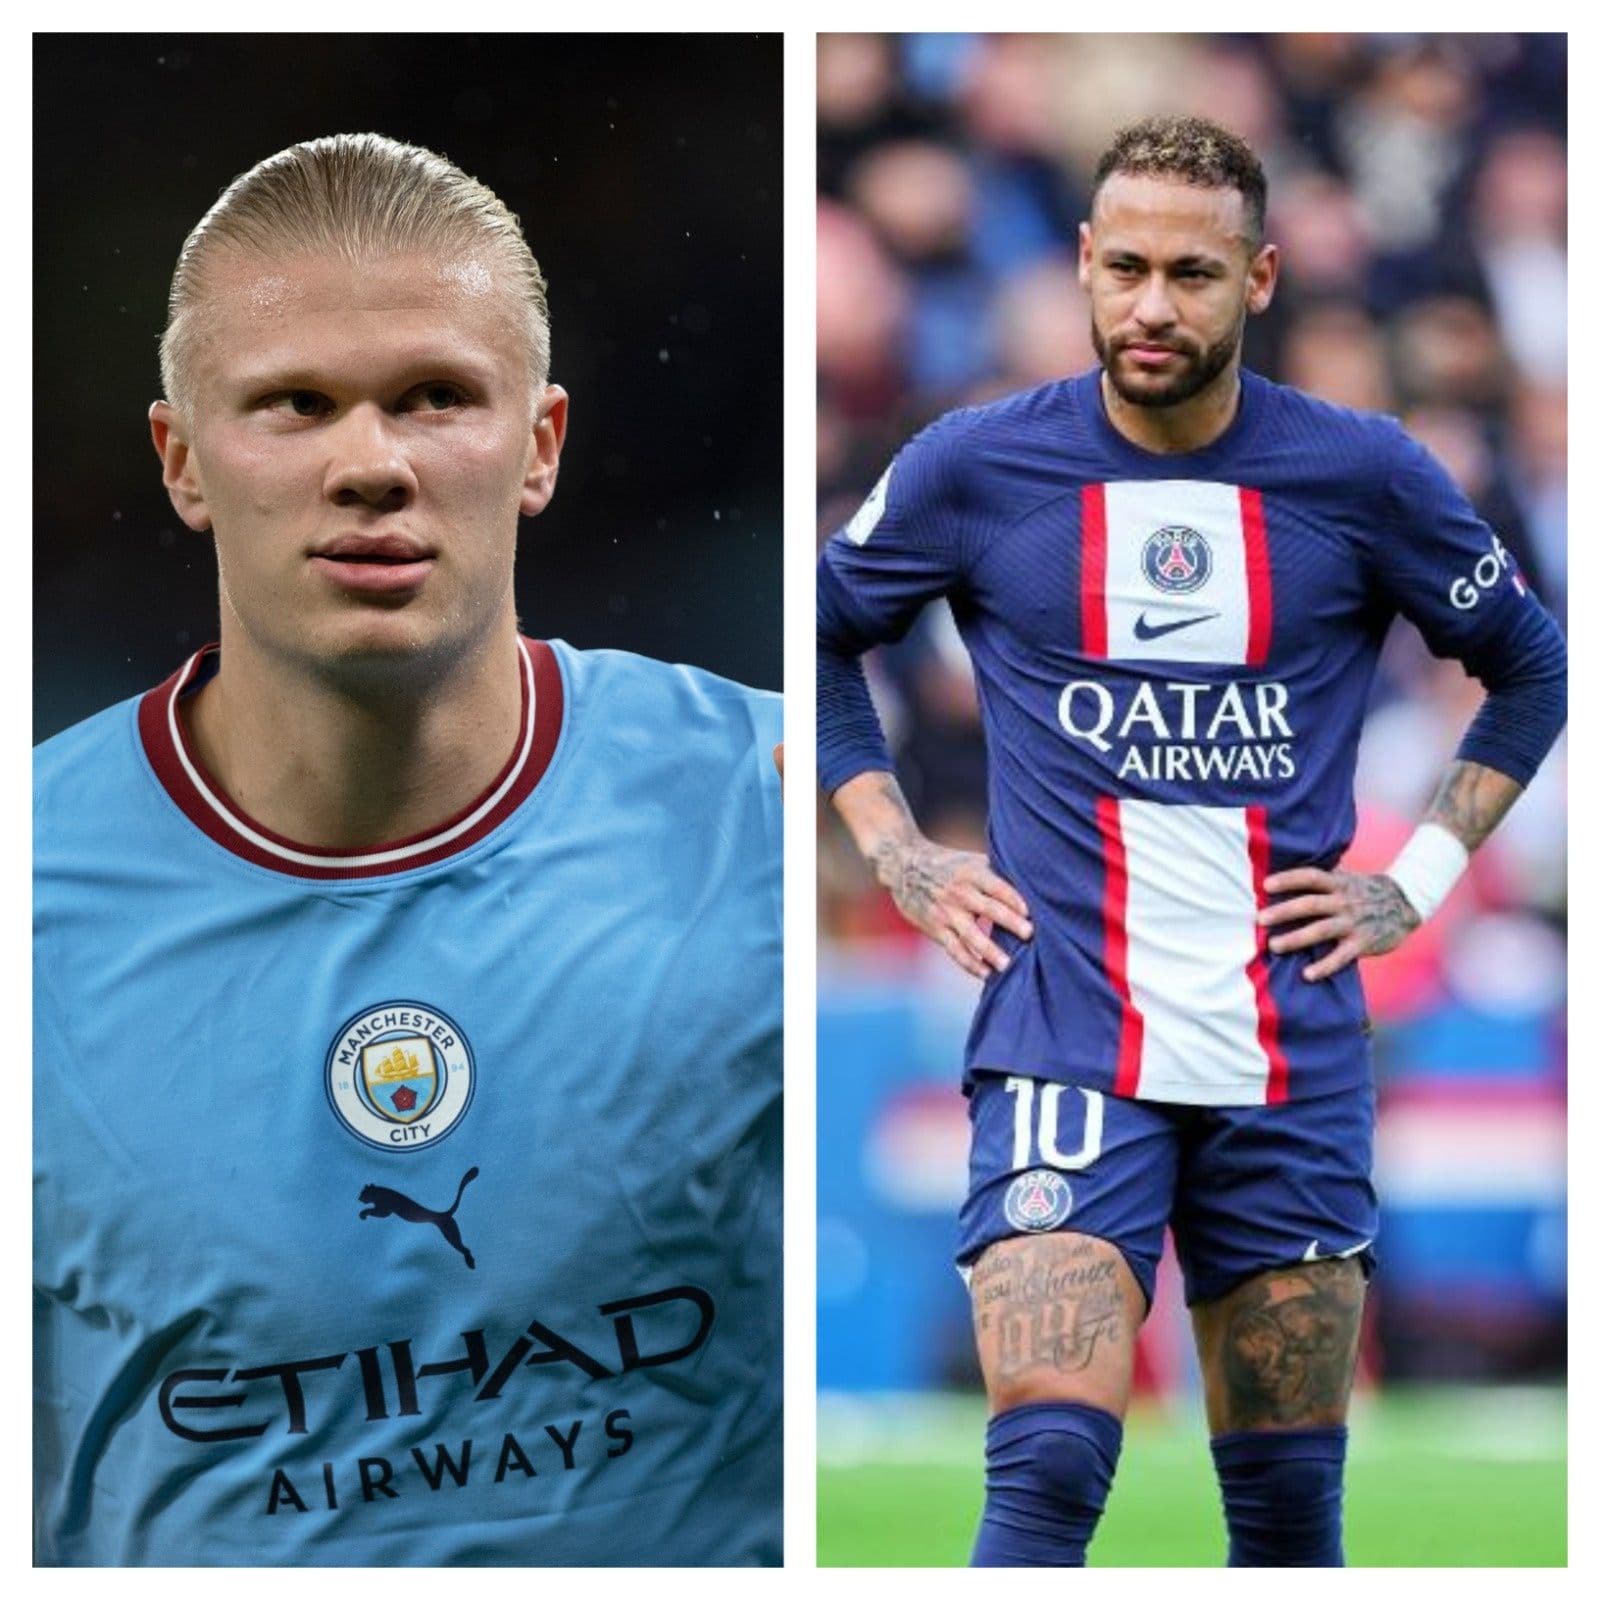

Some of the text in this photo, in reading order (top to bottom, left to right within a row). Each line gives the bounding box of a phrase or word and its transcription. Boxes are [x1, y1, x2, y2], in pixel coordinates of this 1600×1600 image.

[1058, 681, 1295, 752] QATAR
[1117, 743, 1295, 780] AIRWAYS
[339, 1012, 455, 1065] MANCHESTER
[390, 1123, 431, 1142] CITY
[1004, 1076, 1104, 1170] 10
[158, 1285, 715, 1443] ETIHAD
[267, 1409, 634, 1516] AIRWAYS
